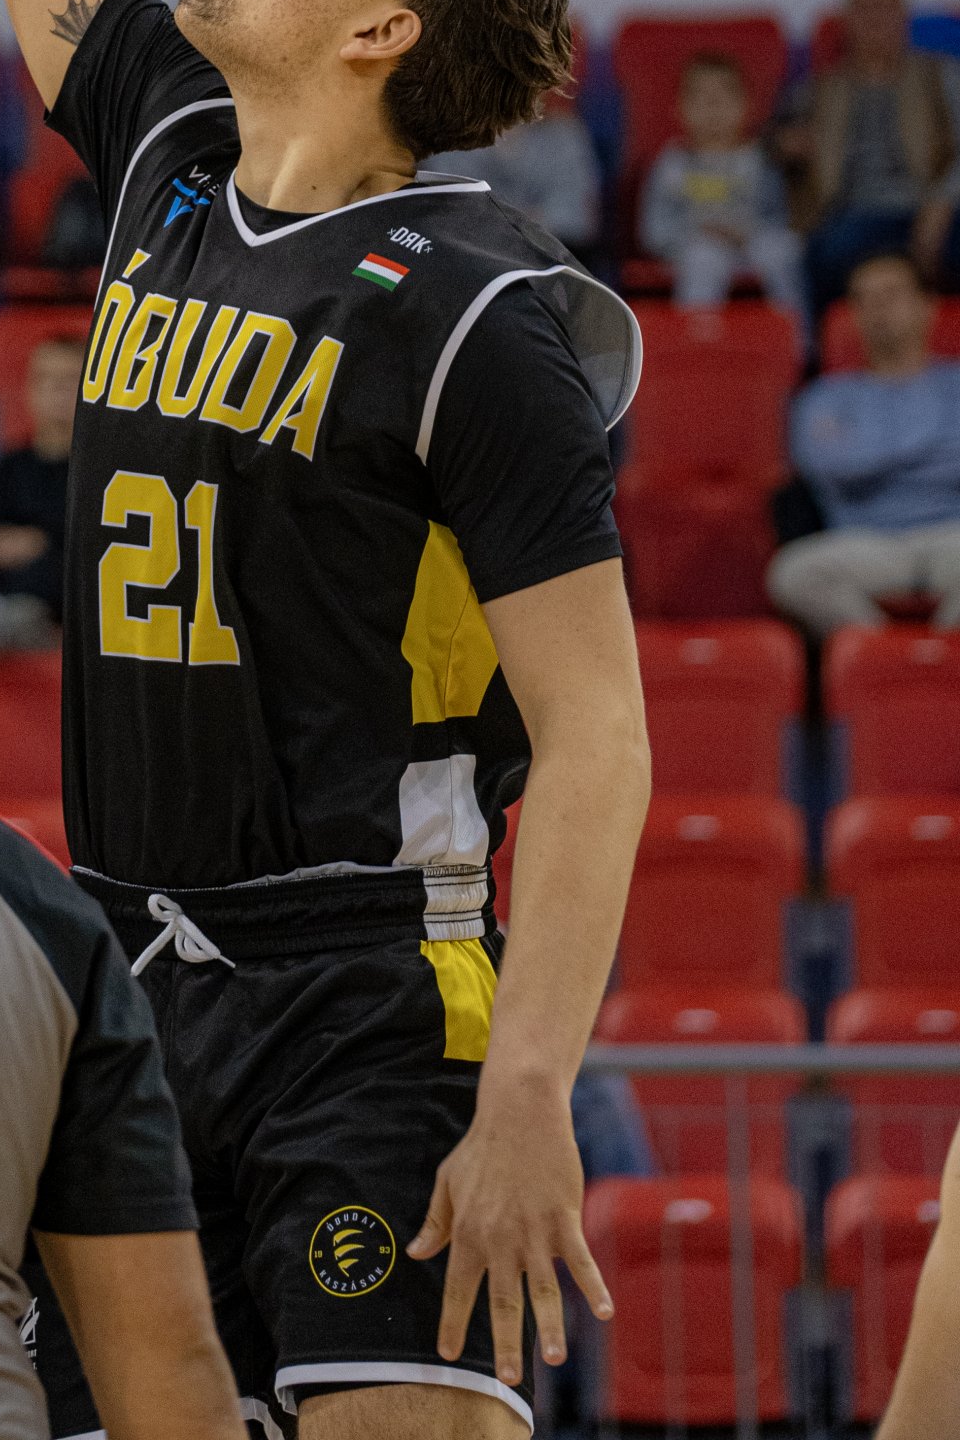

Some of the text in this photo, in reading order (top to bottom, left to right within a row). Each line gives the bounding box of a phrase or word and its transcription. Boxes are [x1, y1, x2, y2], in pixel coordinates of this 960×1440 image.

[82, 248, 345, 462] ÓBUDA
[98, 469, 241, 665] 21
[326, 1212, 376, 1232] ÓBUDAI
[319, 1266, 384, 1291] KASZÁSOK
